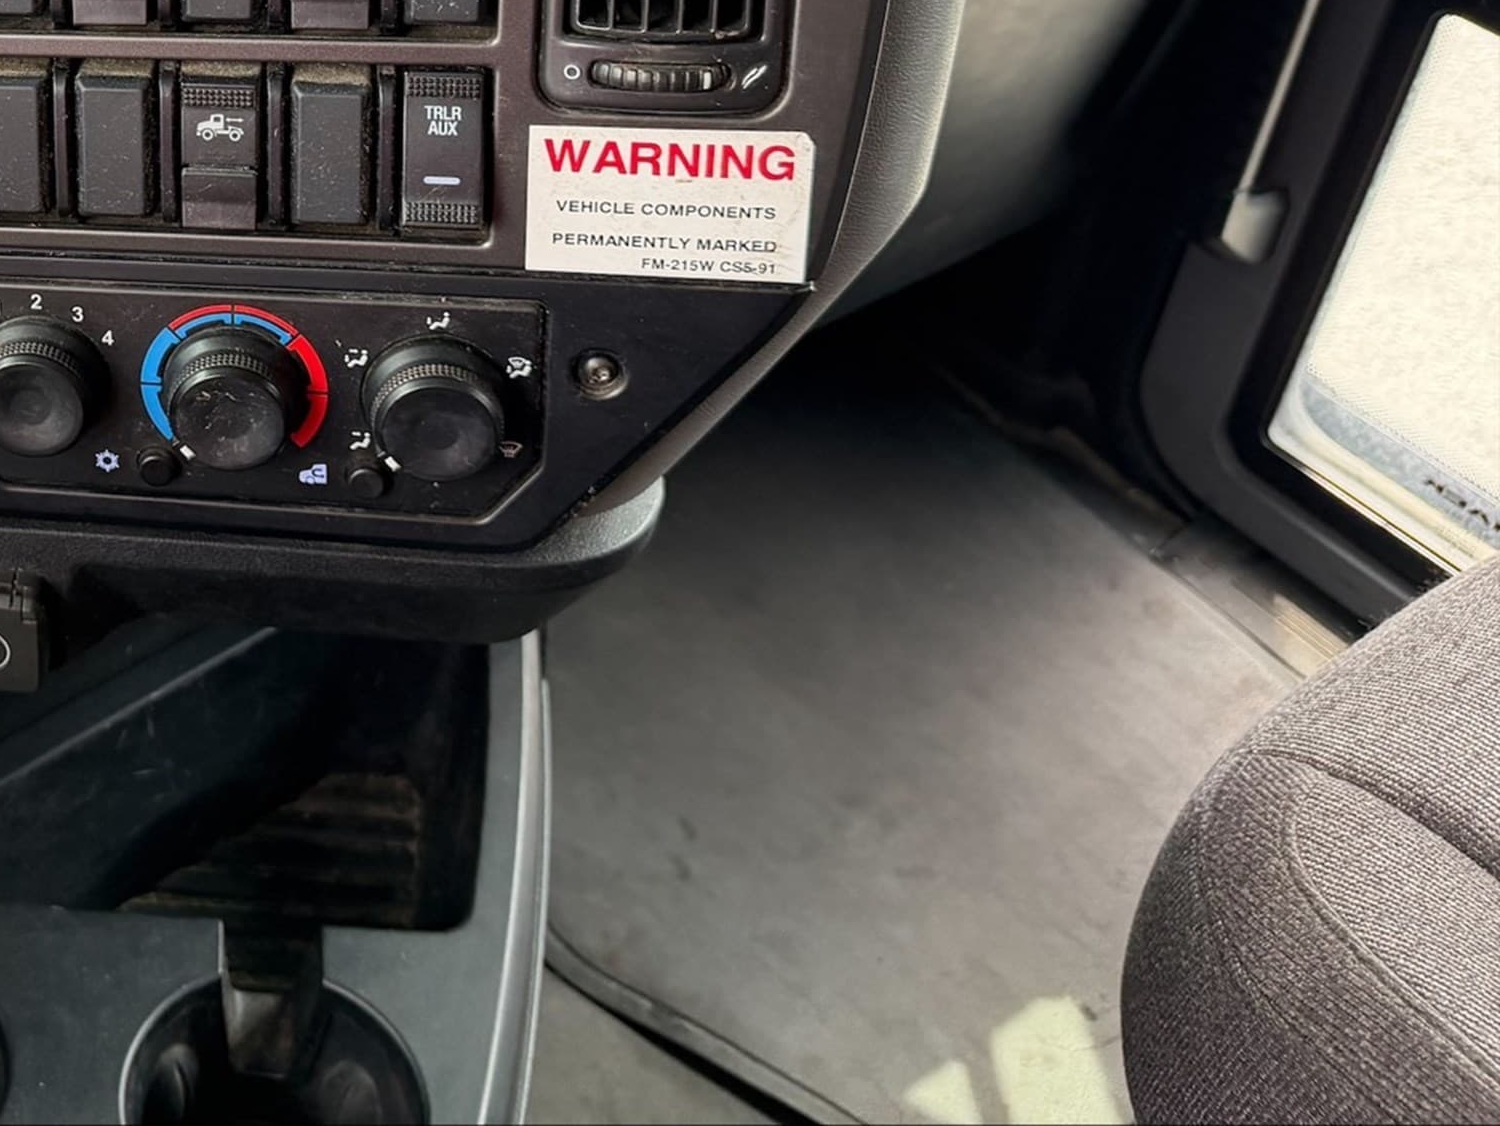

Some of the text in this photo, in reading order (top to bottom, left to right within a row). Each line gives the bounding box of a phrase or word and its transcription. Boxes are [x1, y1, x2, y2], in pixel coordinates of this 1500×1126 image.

[424, 105, 461, 121] TRLR
[428, 120, 457, 136] AUX
[544, 138, 796, 181] WARNING
[556, 200, 776, 220] VEHICLE COMPONENTS
[552, 233, 777, 253] PERMANENTLY MARKED
[641, 258, 715, 273] FM-215W
[30, 294, 43, 310] 2
[71, 306, 84, 323] 3
[101, 330, 115, 346] 4
